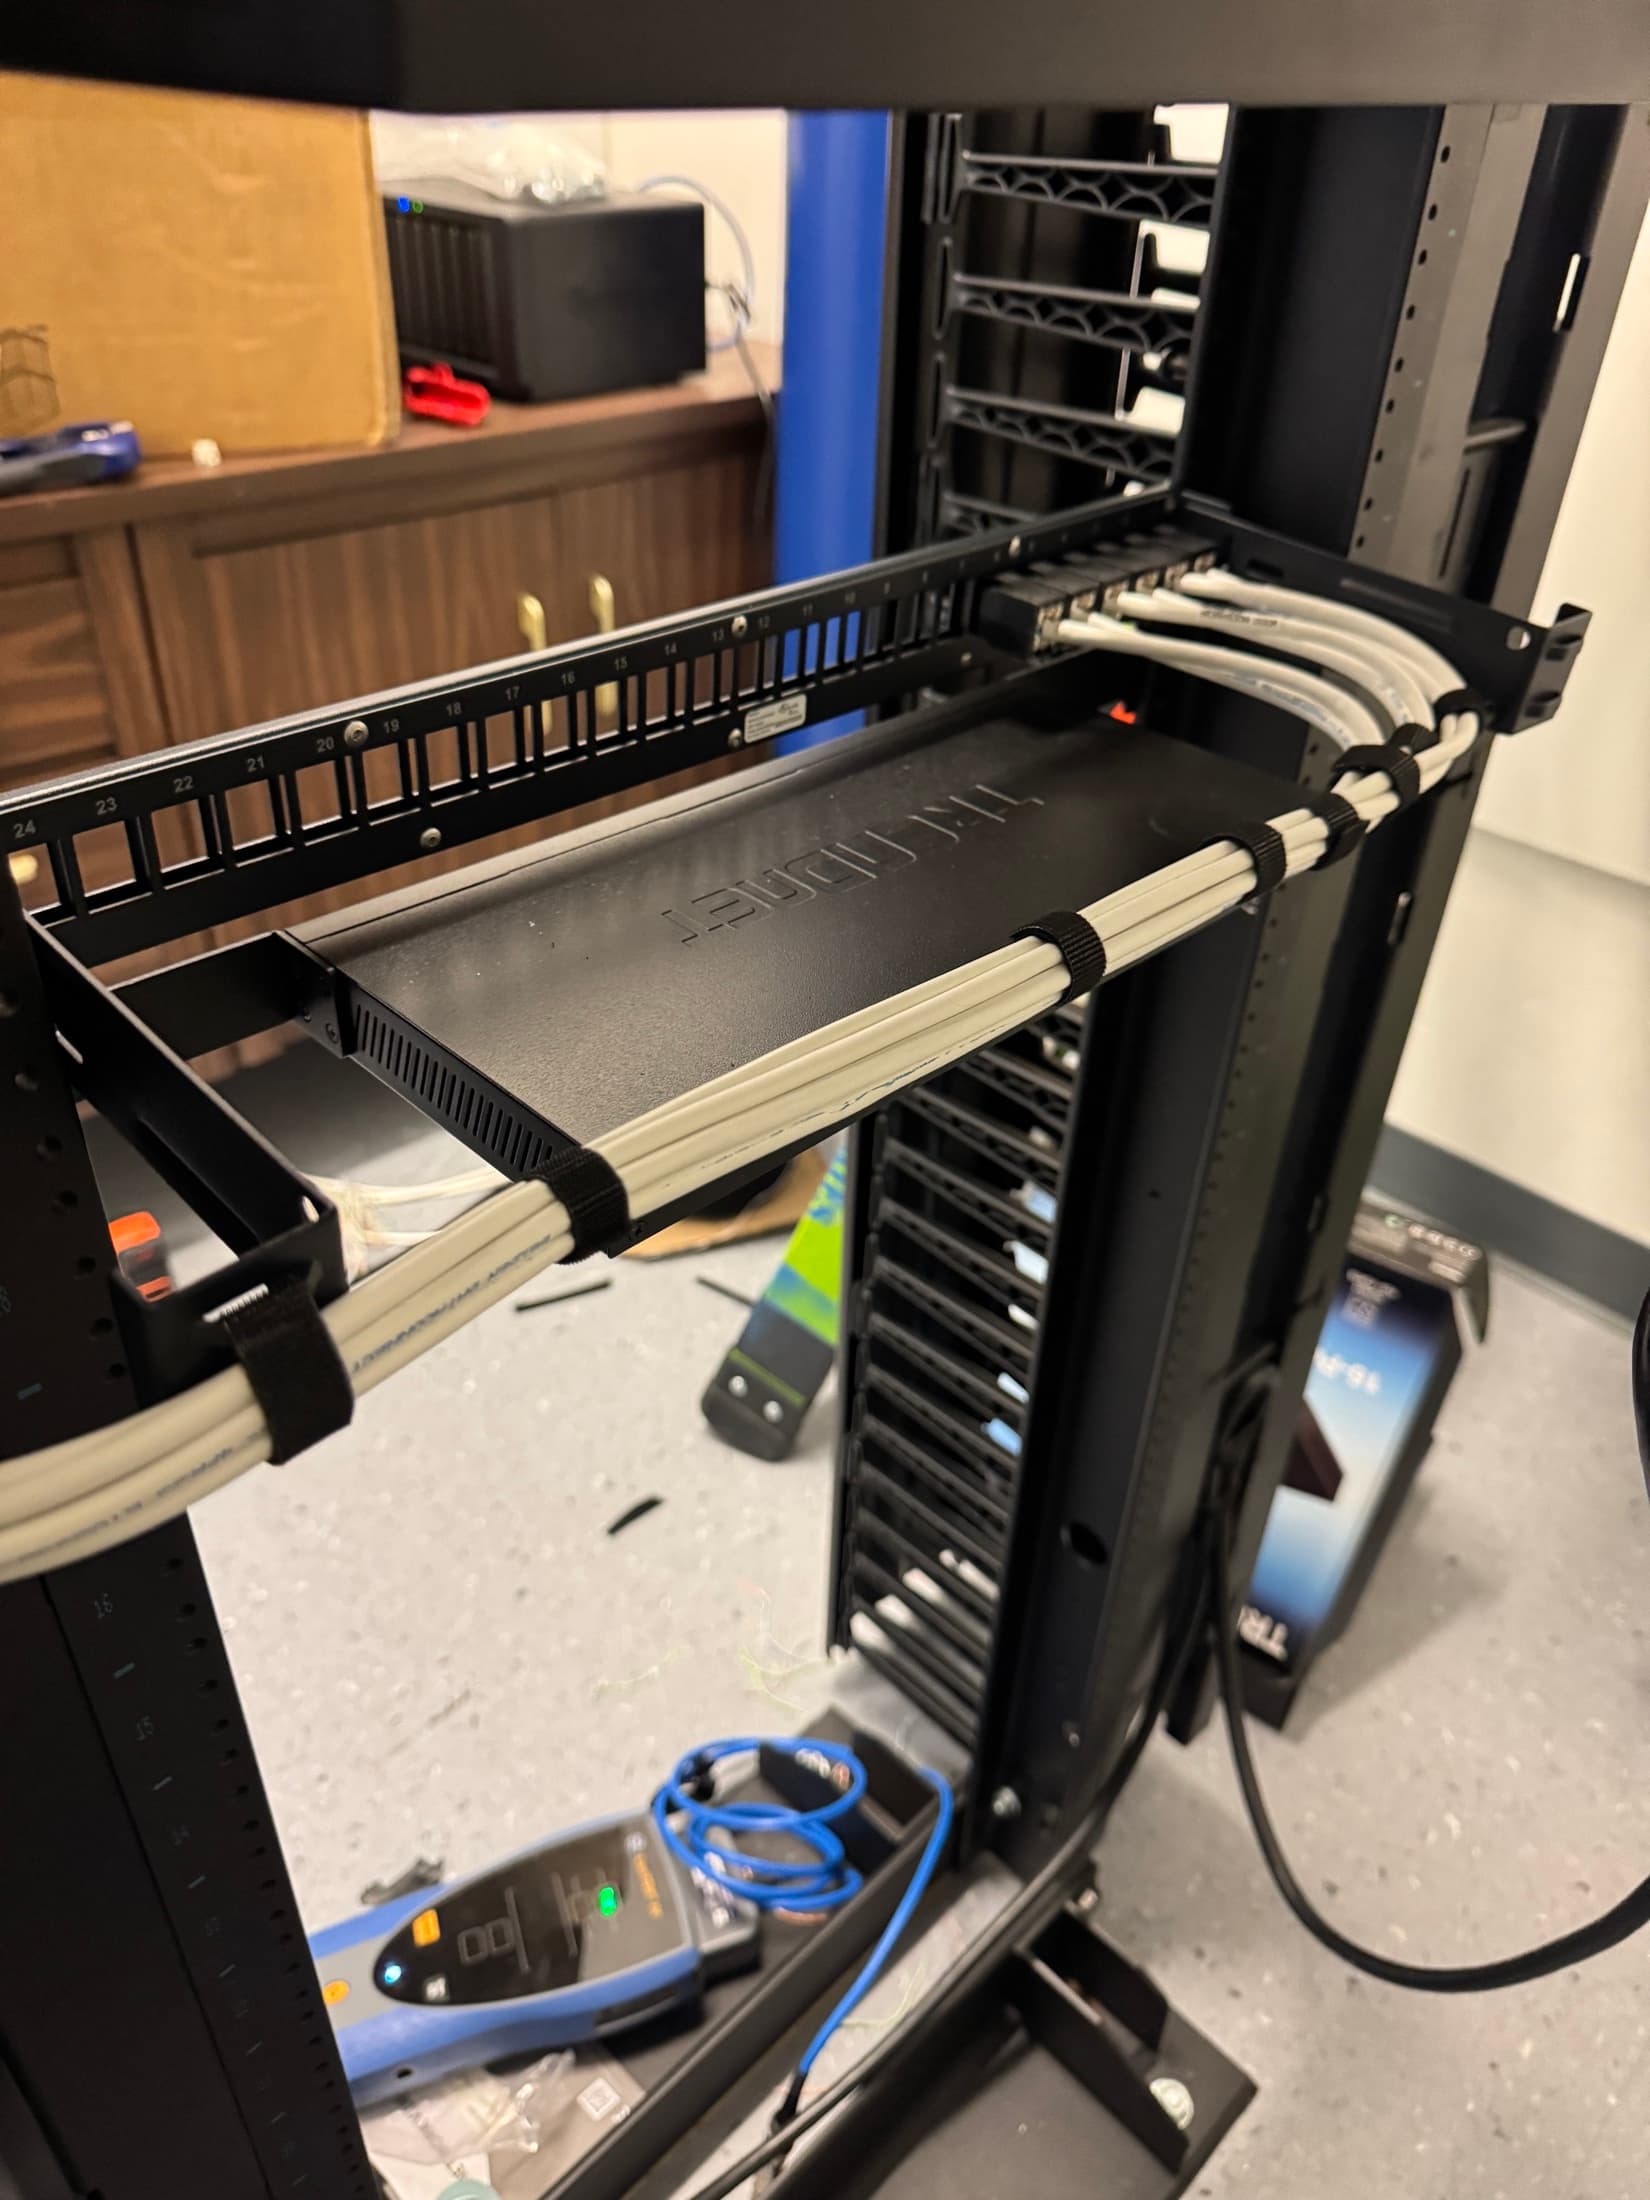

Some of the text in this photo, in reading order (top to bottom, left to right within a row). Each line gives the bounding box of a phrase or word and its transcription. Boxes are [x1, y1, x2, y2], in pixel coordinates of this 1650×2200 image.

[13, 818, 37, 838] 24
[96, 797, 118, 815] 23
[173, 775, 194, 793] 22
[246, 755, 265, 773] 21
[316, 736, 335, 754] 20
[383, 719, 400, 734] 19
[446, 703, 462, 717] 18
[504, 685, 520, 700] 17
[560, 671, 575, 685] 16
[613, 656, 628, 670] 15
[663, 641, 678, 656] 14
